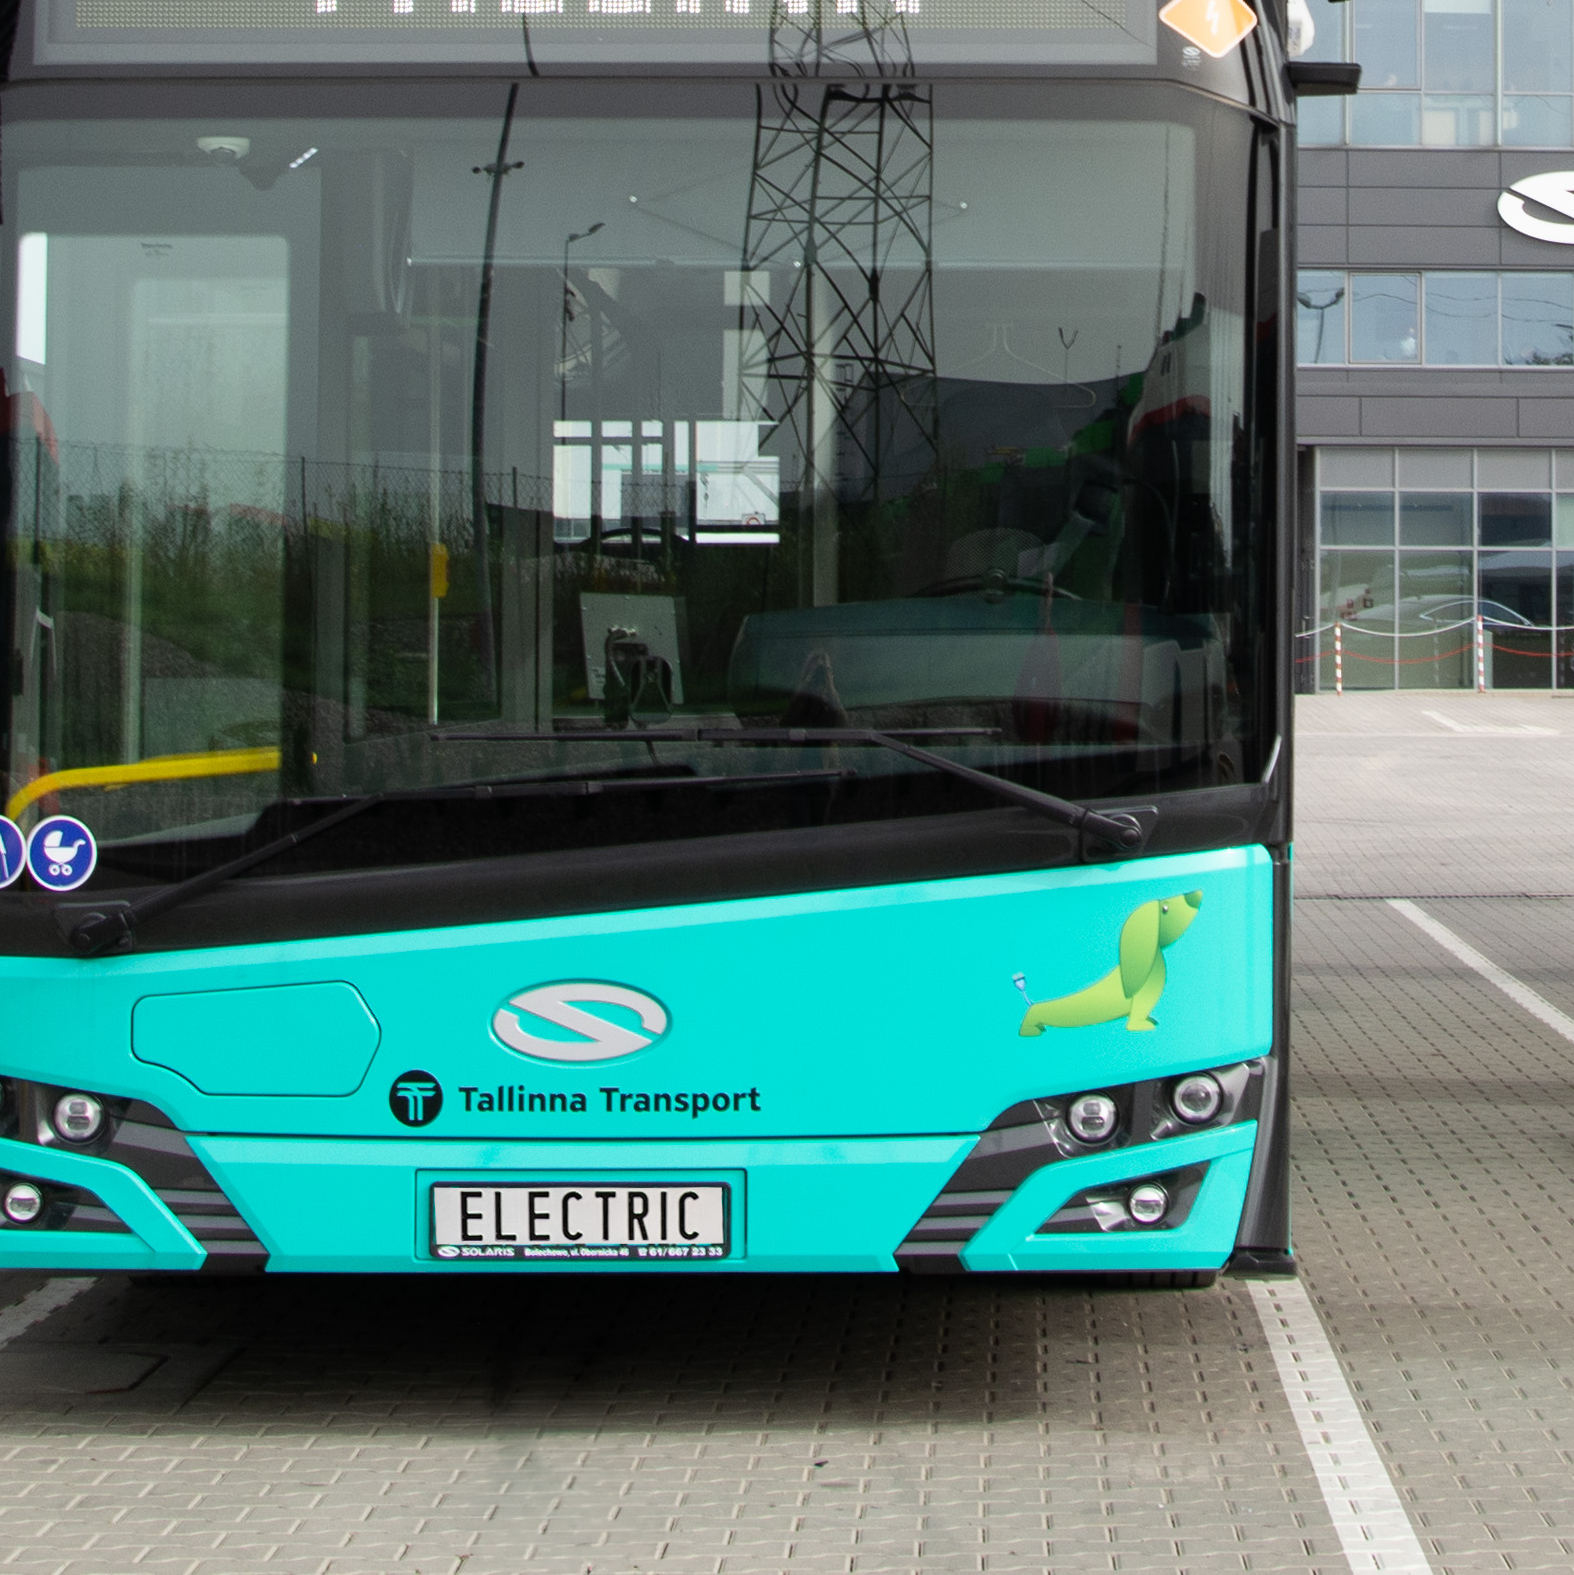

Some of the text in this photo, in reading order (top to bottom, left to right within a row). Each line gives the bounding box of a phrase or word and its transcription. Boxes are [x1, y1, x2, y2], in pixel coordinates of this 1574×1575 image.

[459, 1085, 762, 1119] Tallinna Transport
[460, 1191, 700, 1241] ELECTRIC
[461, 1247, 515, 1257] SOLARIS
[691, 1247, 706, 1257] 23
[708, 1247, 723, 1257] 33
